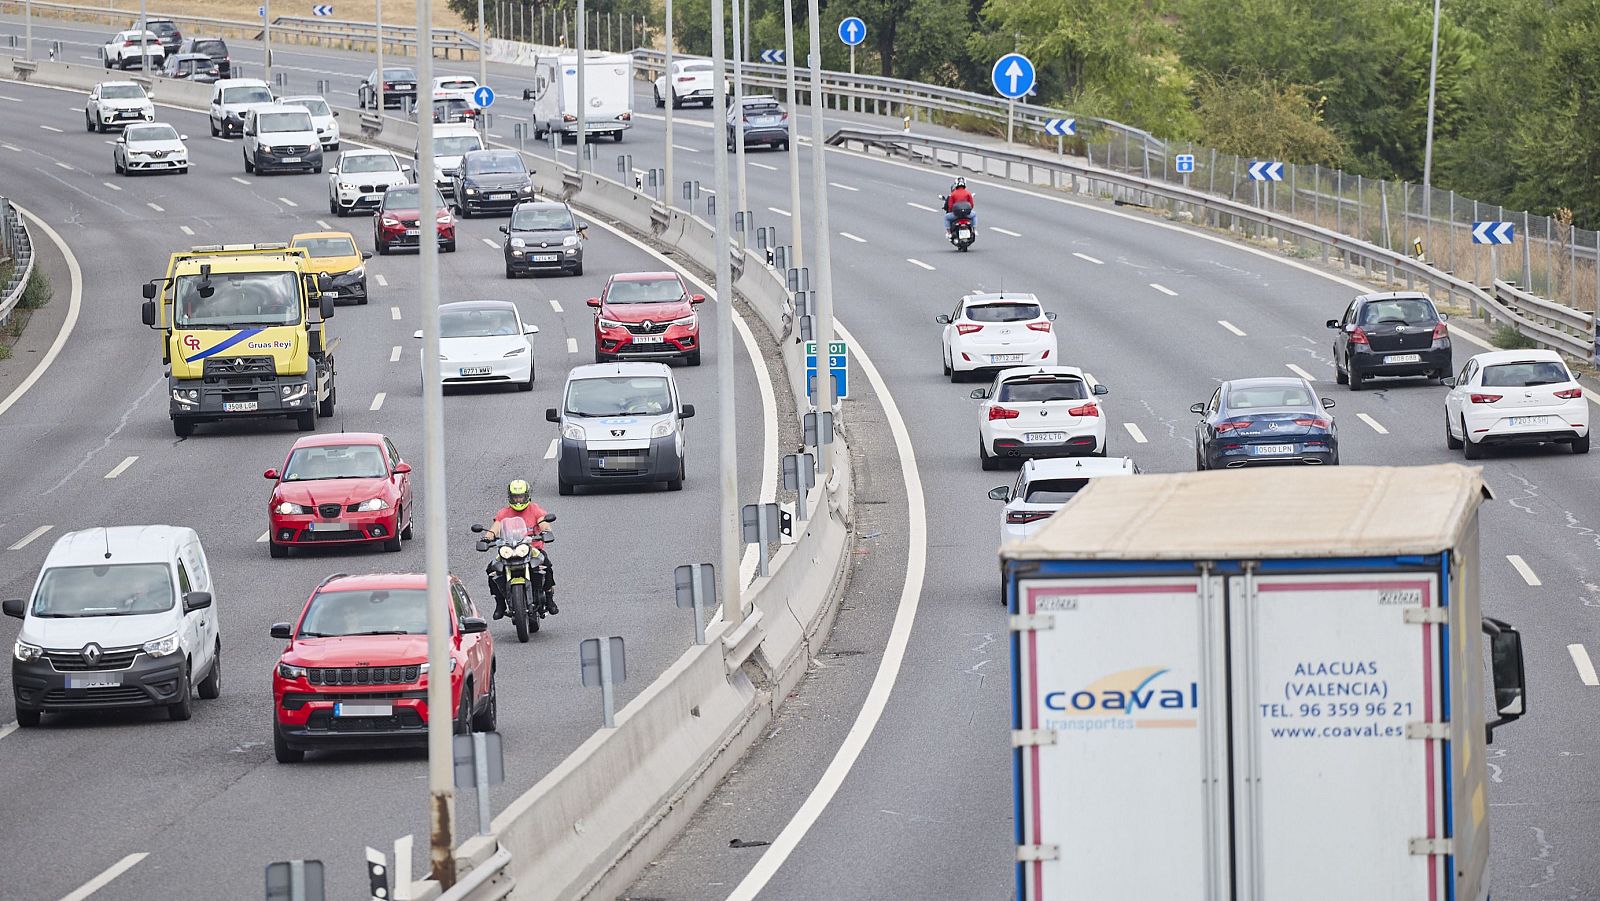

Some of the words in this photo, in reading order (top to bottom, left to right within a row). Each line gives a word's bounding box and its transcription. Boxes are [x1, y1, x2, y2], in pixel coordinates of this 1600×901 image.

[183, 334, 201, 351] GR
[248, 341, 272, 349] Gruas
[273, 340, 292, 349] Reyi
[1294, 661, 1377, 676] ALACUAS
[1044, 682, 1198, 711] coaval
[1285, 680, 1388, 699] (VALENCIA)
[1260, 704, 1293, 717] TEL.
[1299, 703, 1321, 717] 96
[1327, 703, 1359, 717] 359
[1365, 702, 1386, 716] 96
[1393, 702, 1412, 716] 21
[1045, 717, 1134, 732] transportes
[1271, 722, 1403, 738] www.coaval.es
